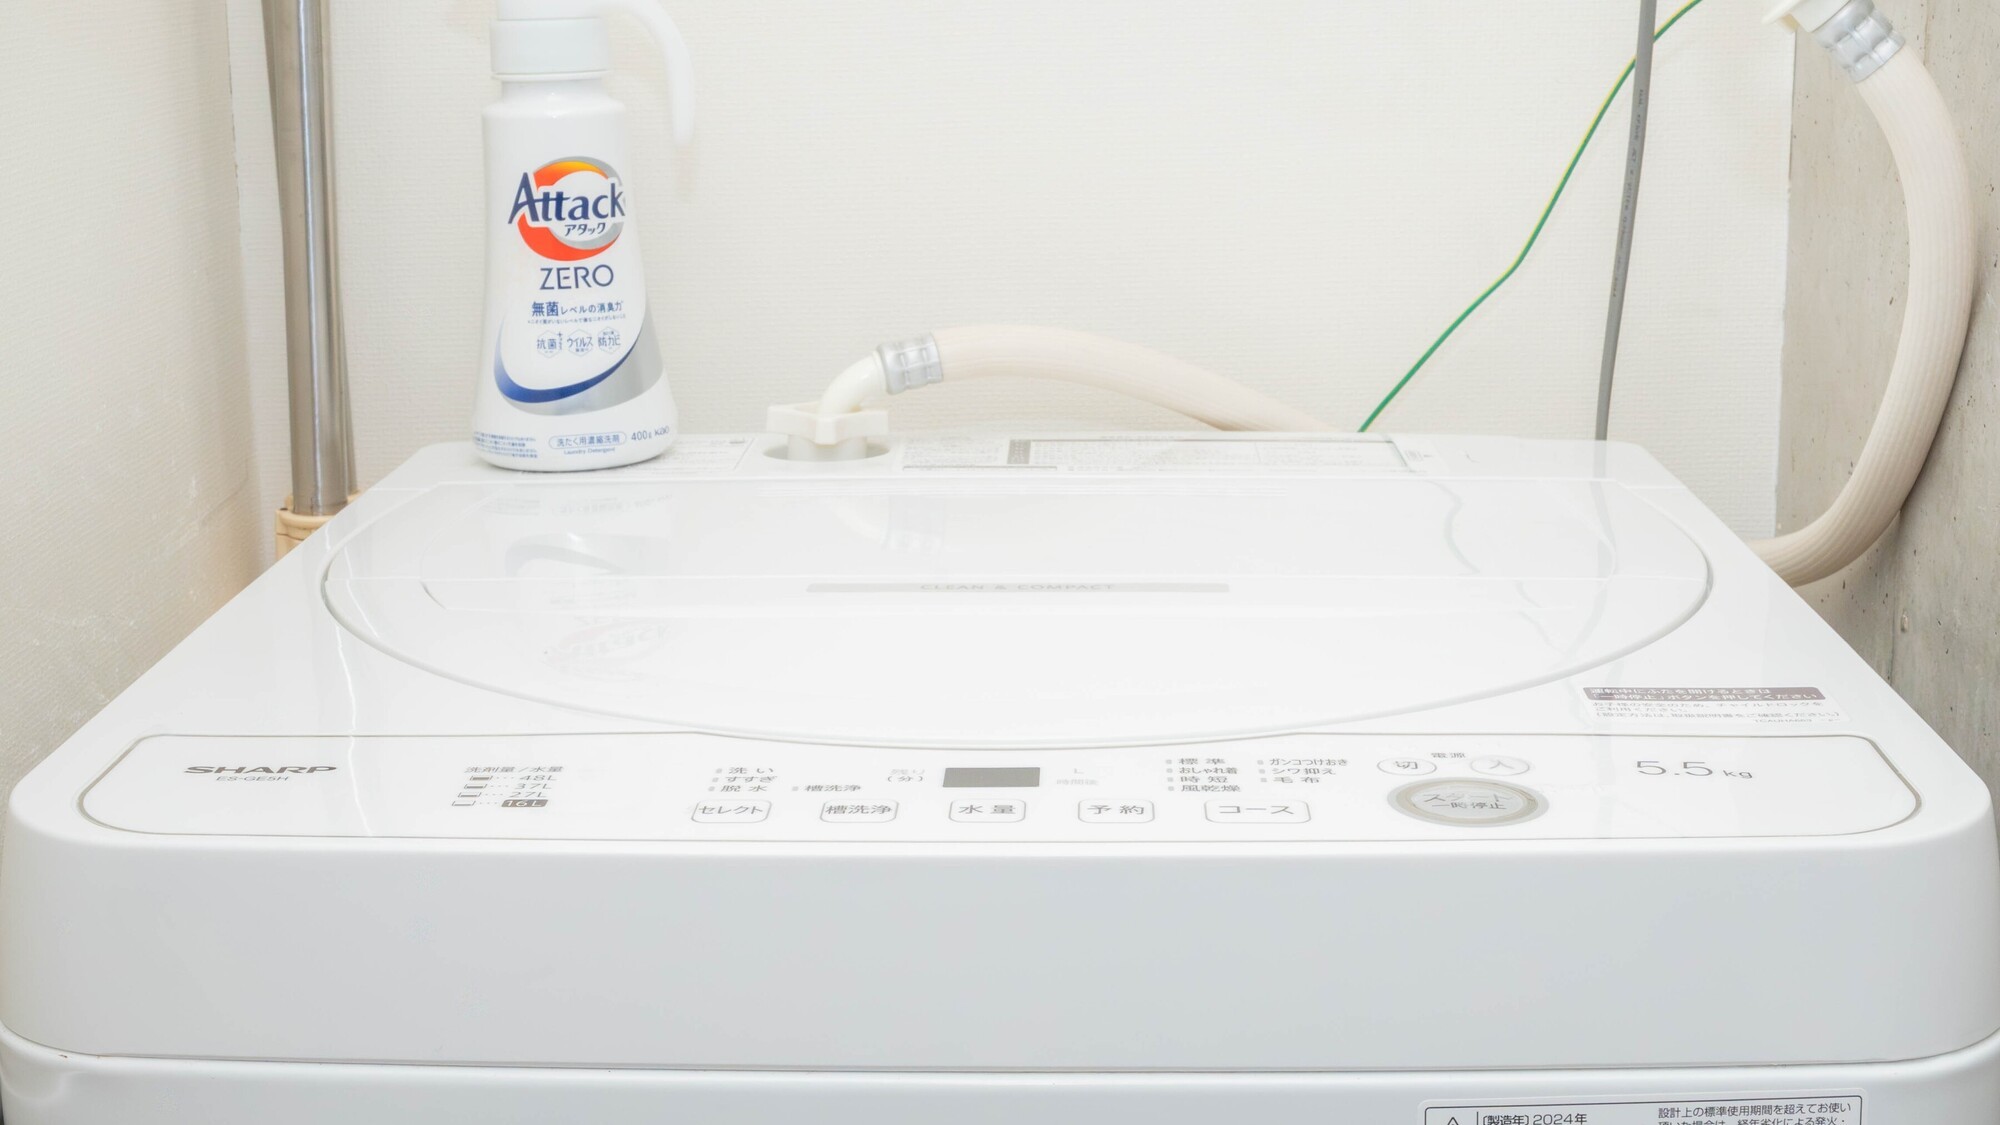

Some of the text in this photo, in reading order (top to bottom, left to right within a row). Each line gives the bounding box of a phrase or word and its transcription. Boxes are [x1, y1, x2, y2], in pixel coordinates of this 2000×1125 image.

[508, 172, 626, 224] Attack
[564, 222, 606, 236] アタック
[540, 264, 614, 290] ZERO
[532, 300, 623, 317] 無菌レベルの消臭力
[566, 336, 594, 349] ウイルス
[598, 334, 621, 347] 防カビ
[920, 583, 985, 591] CLEAN
[1017, 583, 1115, 591] COMPACT
[1269, 758, 1348, 766] ガンコつけおき
[1395, 761, 1418, 769] 切
[1489, 759, 1515, 769] 入
[184, 766, 338, 774] SHARP
[1271, 767, 1336, 775] シワ抑え
[1636, 761, 1753, 779] 5.5 kg
[725, 775, 778, 783] すすぎ
[804, 784, 861, 792] 槽洗浄
[1181, 784, 1241, 792] 風乾燥
[698, 804, 764, 815] セレクト
[825, 804, 893, 815] 槽洗浄
[957, 804, 1016, 815] 水量
[1087, 804, 1145, 815] 予約
[1218, 805, 1295, 815] コース
[1431, 801, 1507, 809] 一時停止
[1658, 1102, 1851, 1119] 設計上の標準使用期間を超えてお使い
[1532, 1112, 1588, 1125] 2024年
